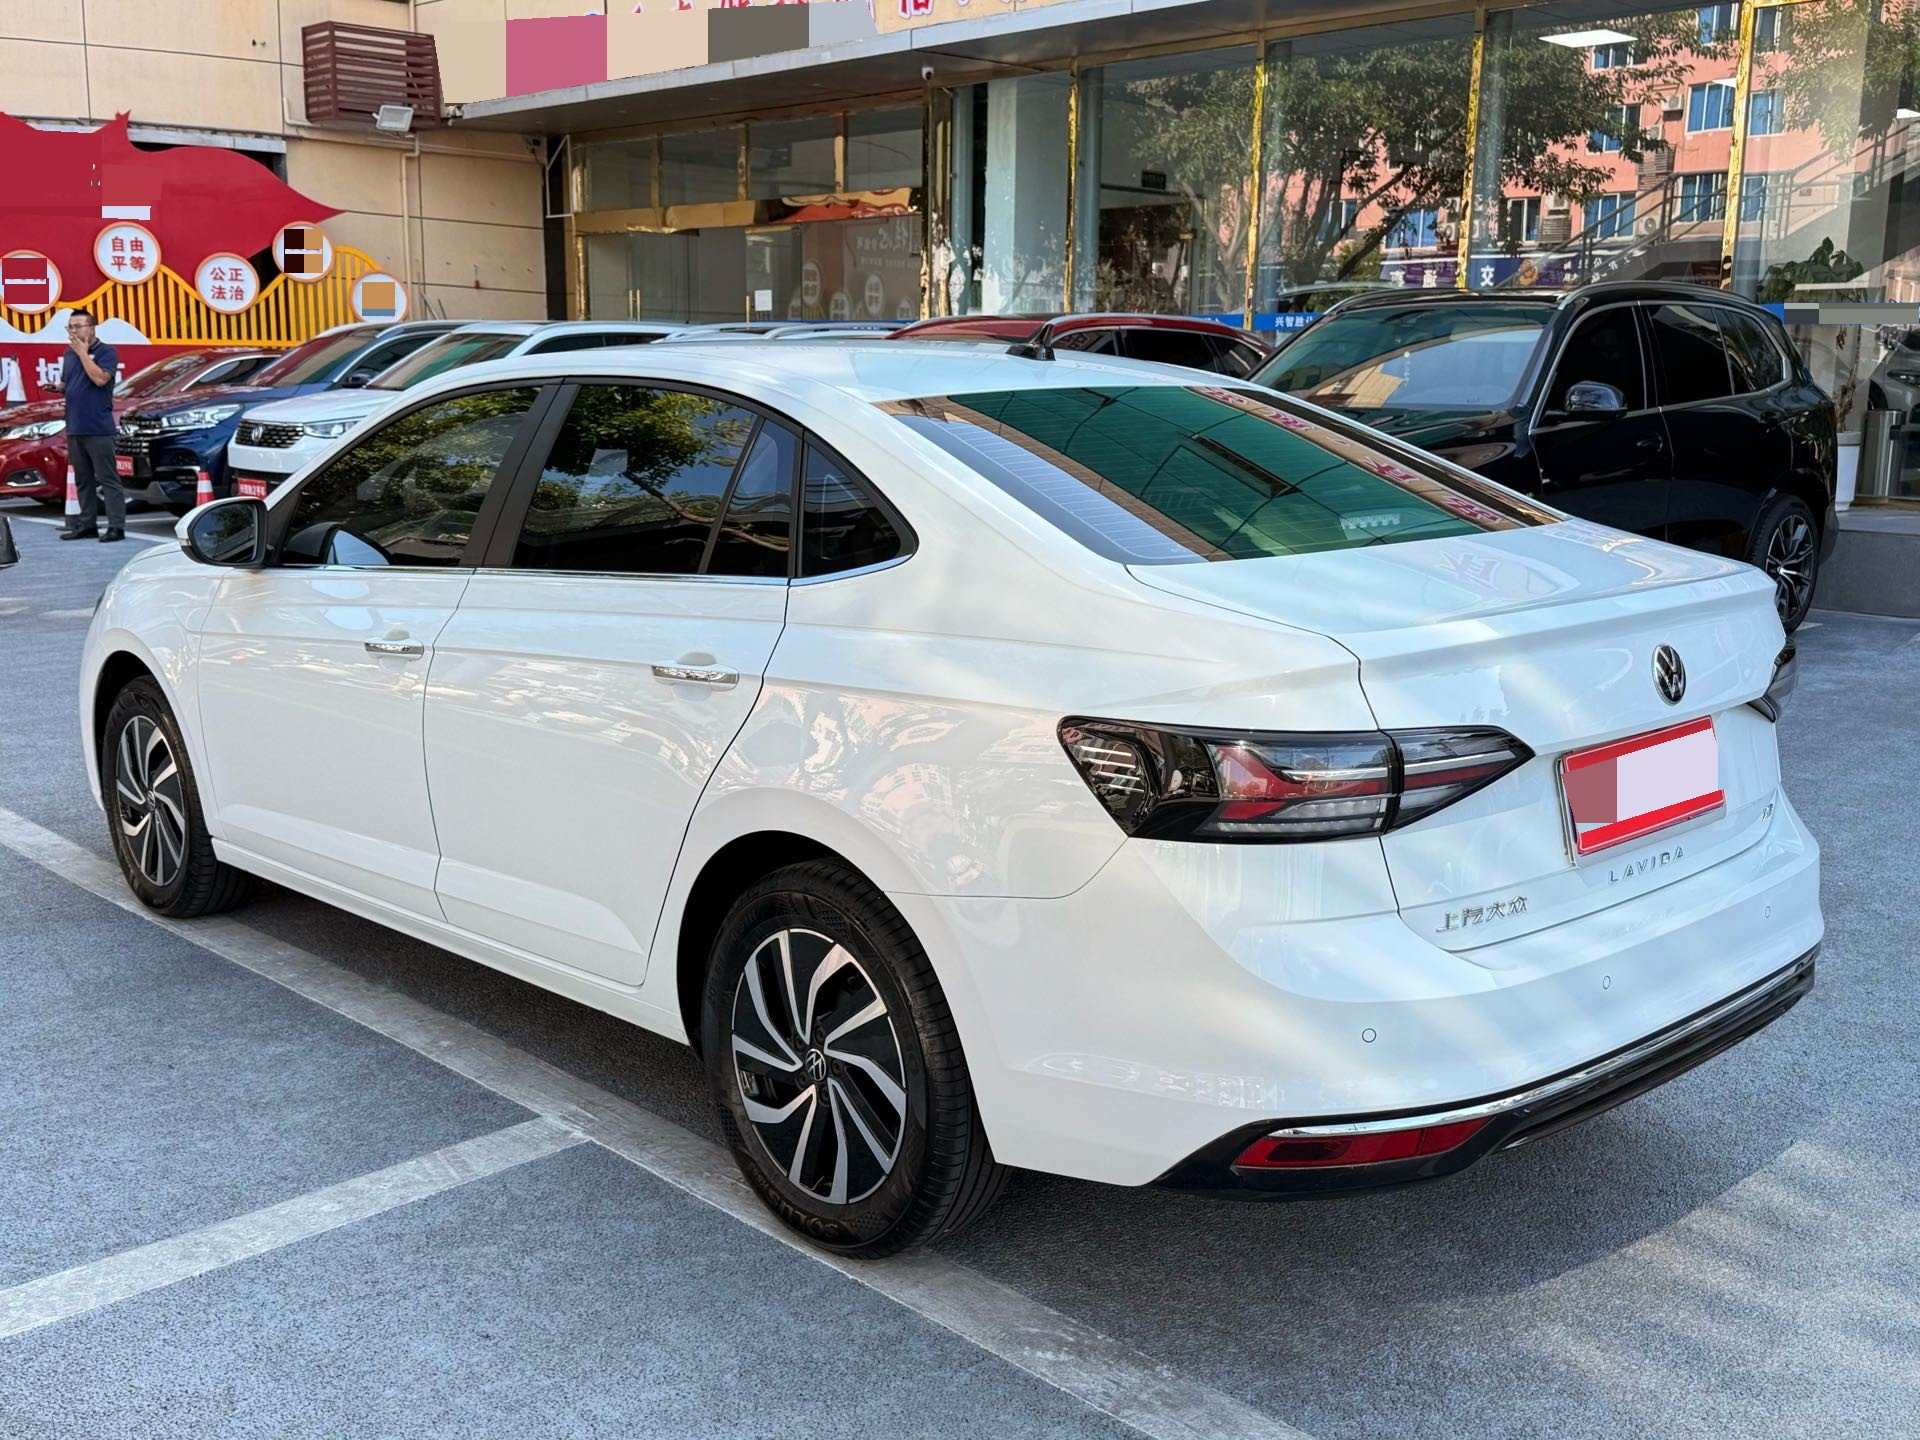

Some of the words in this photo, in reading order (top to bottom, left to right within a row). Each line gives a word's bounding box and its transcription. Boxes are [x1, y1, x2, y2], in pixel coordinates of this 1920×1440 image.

[111, 236, 144, 252] 自由
[111, 256, 146, 272] 平等
[210, 267, 244, 282] 公正
[211, 285, 245, 301] 法治
[1609, 846, 1684, 884] LAVIDA
[1436, 896, 1528, 933] 上汽大众
